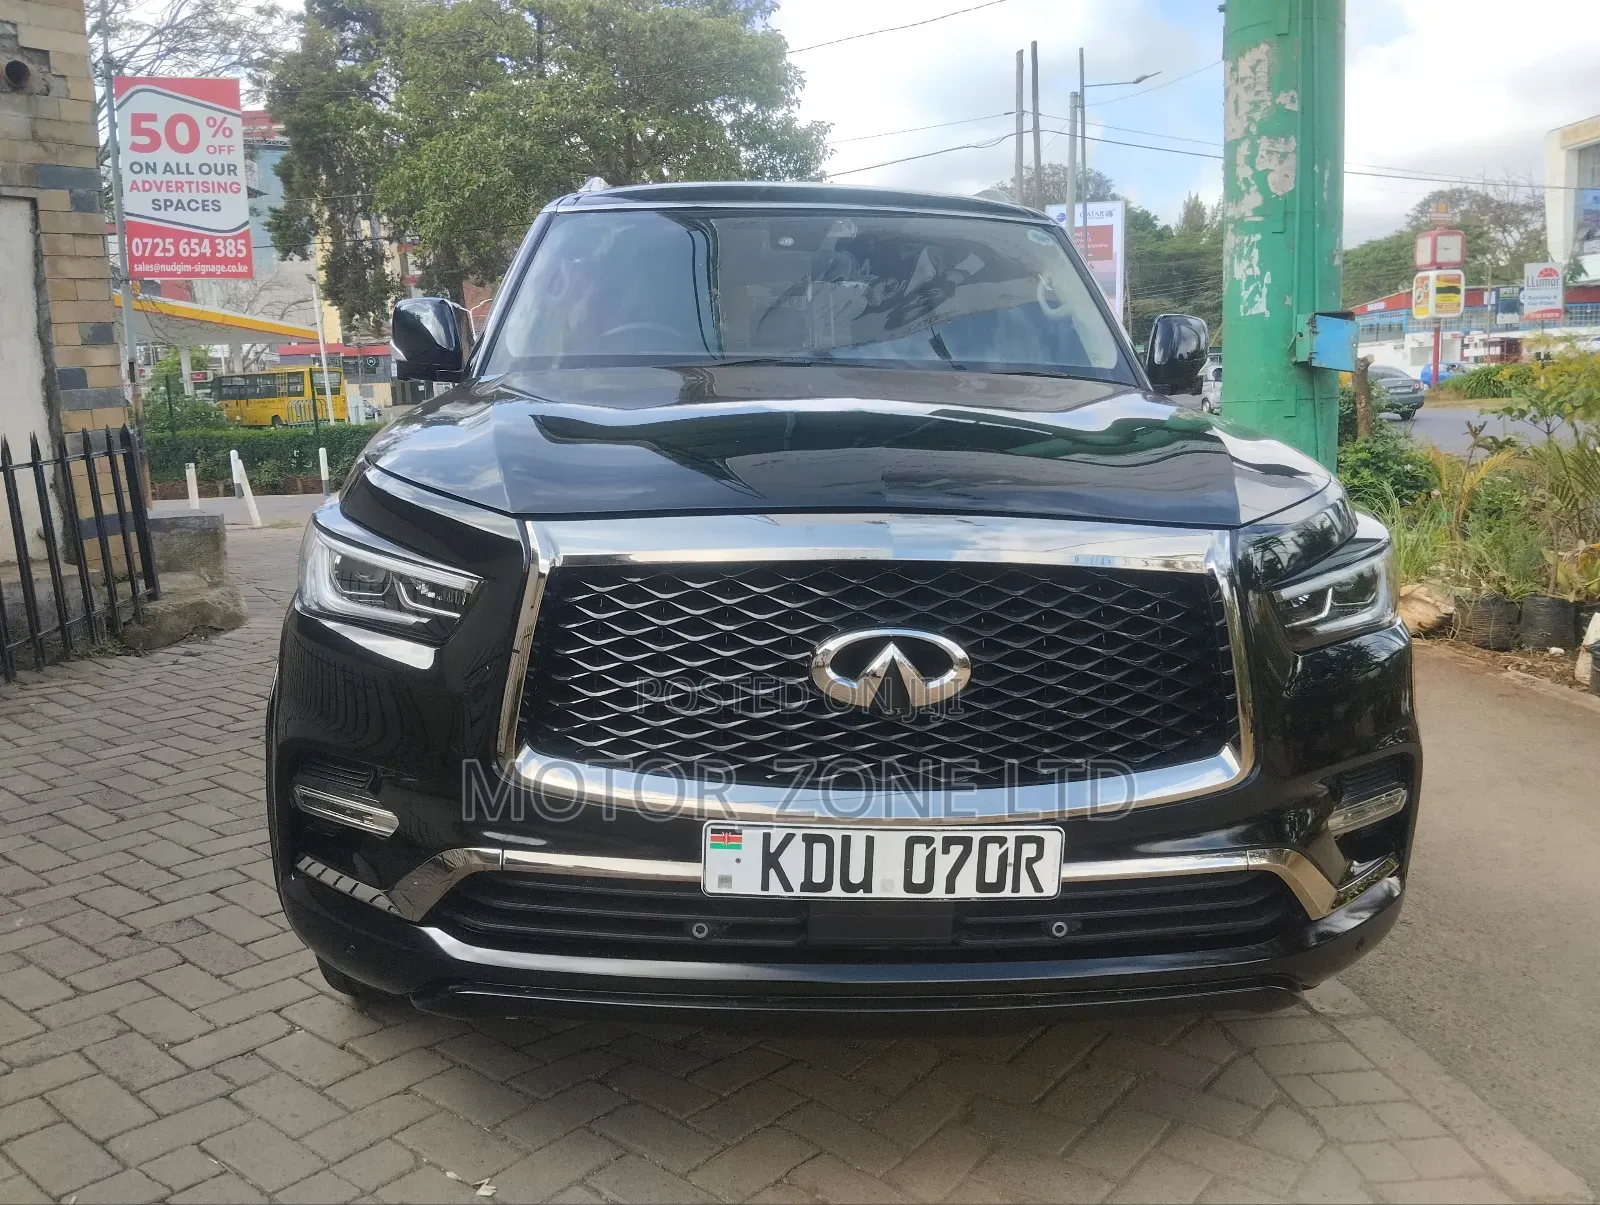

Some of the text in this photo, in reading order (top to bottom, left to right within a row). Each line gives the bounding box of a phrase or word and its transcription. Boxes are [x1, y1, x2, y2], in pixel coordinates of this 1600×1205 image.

[206, 144, 235, 155] OFF
[129, 161, 238, 177] ON ALL OUR
[129, 179, 241, 195] ADVERTISING
[151, 198, 222, 213] SPACES
[132, 237, 247, 258] 0725 654 385
[133, 261, 248, 273] sales@nudgim-signage.co.ke
[760, 831, 875, 894] KDU
[903, 833, 1046, 895] 070R
